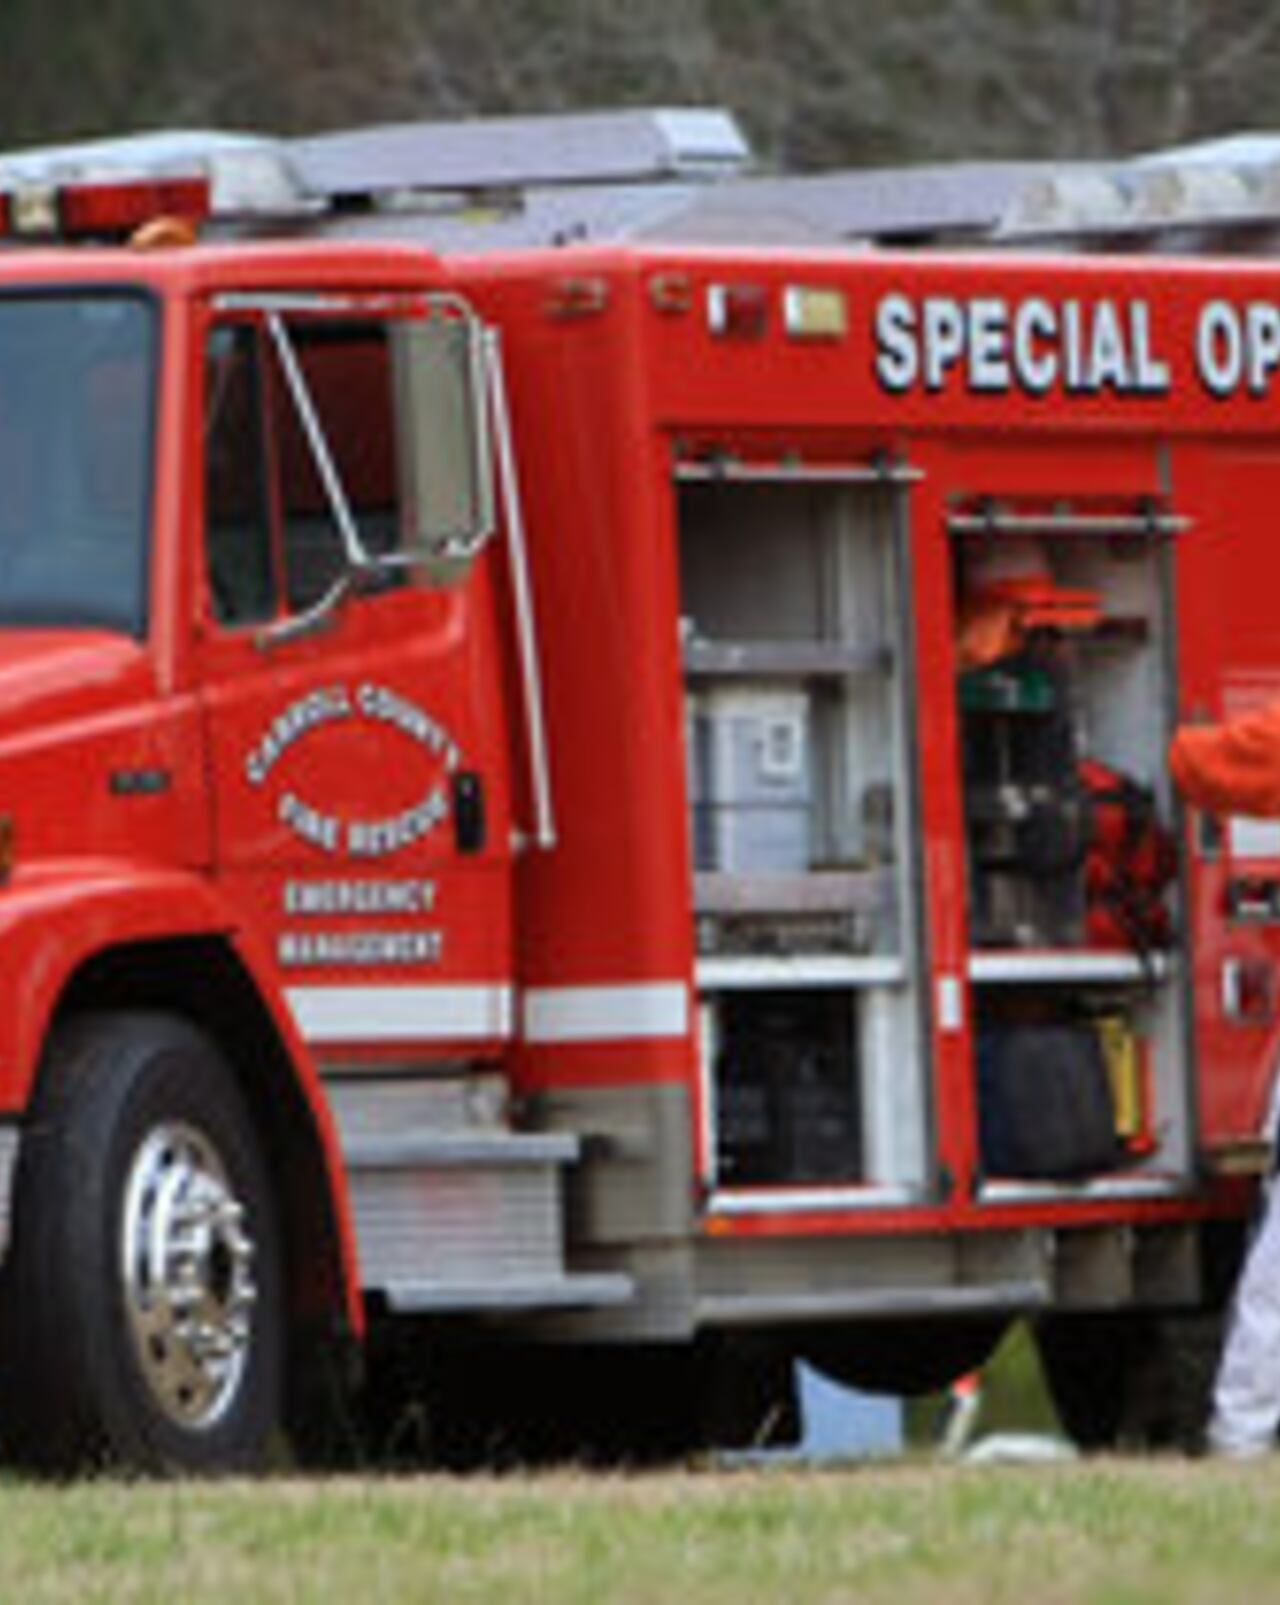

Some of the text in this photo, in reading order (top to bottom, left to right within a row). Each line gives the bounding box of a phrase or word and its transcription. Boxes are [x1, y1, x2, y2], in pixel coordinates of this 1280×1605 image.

[873, 293, 1172, 397] SPECIAL
[245, 680, 460, 786] CARROLL COUNTY
[278, 788, 450, 858] FIRE RESCUE
[284, 878, 437, 915] EMERGENCY
[276, 930, 444, 967] MANAGEMENT
